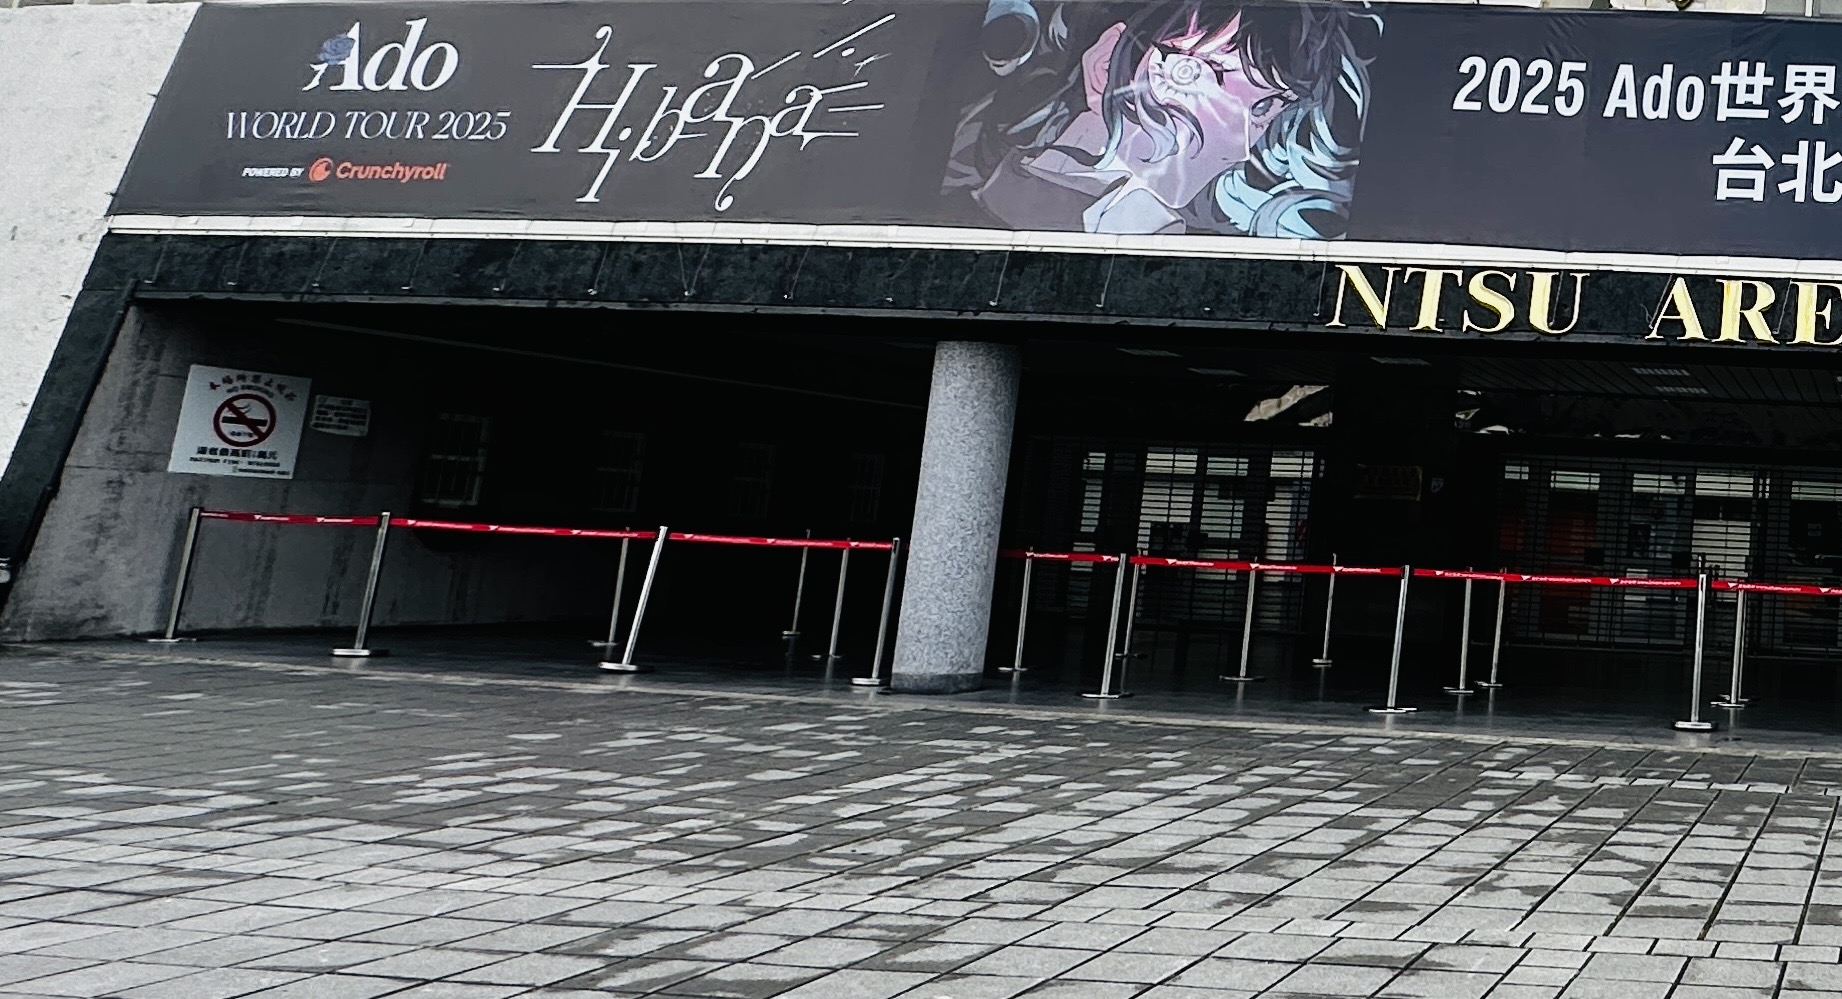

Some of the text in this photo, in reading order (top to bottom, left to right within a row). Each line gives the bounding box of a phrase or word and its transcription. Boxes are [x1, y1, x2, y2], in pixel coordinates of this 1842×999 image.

[302, 18, 459, 92] Ado
[1453, 56, 1587, 118] 2025
[227, 111, 512, 140] WORLD TOUR 2025
[241, 167, 305, 178] POWERED BY
[336, 161, 448, 184] Crunchyroll
[1325, 264, 1590, 335] NTSU
